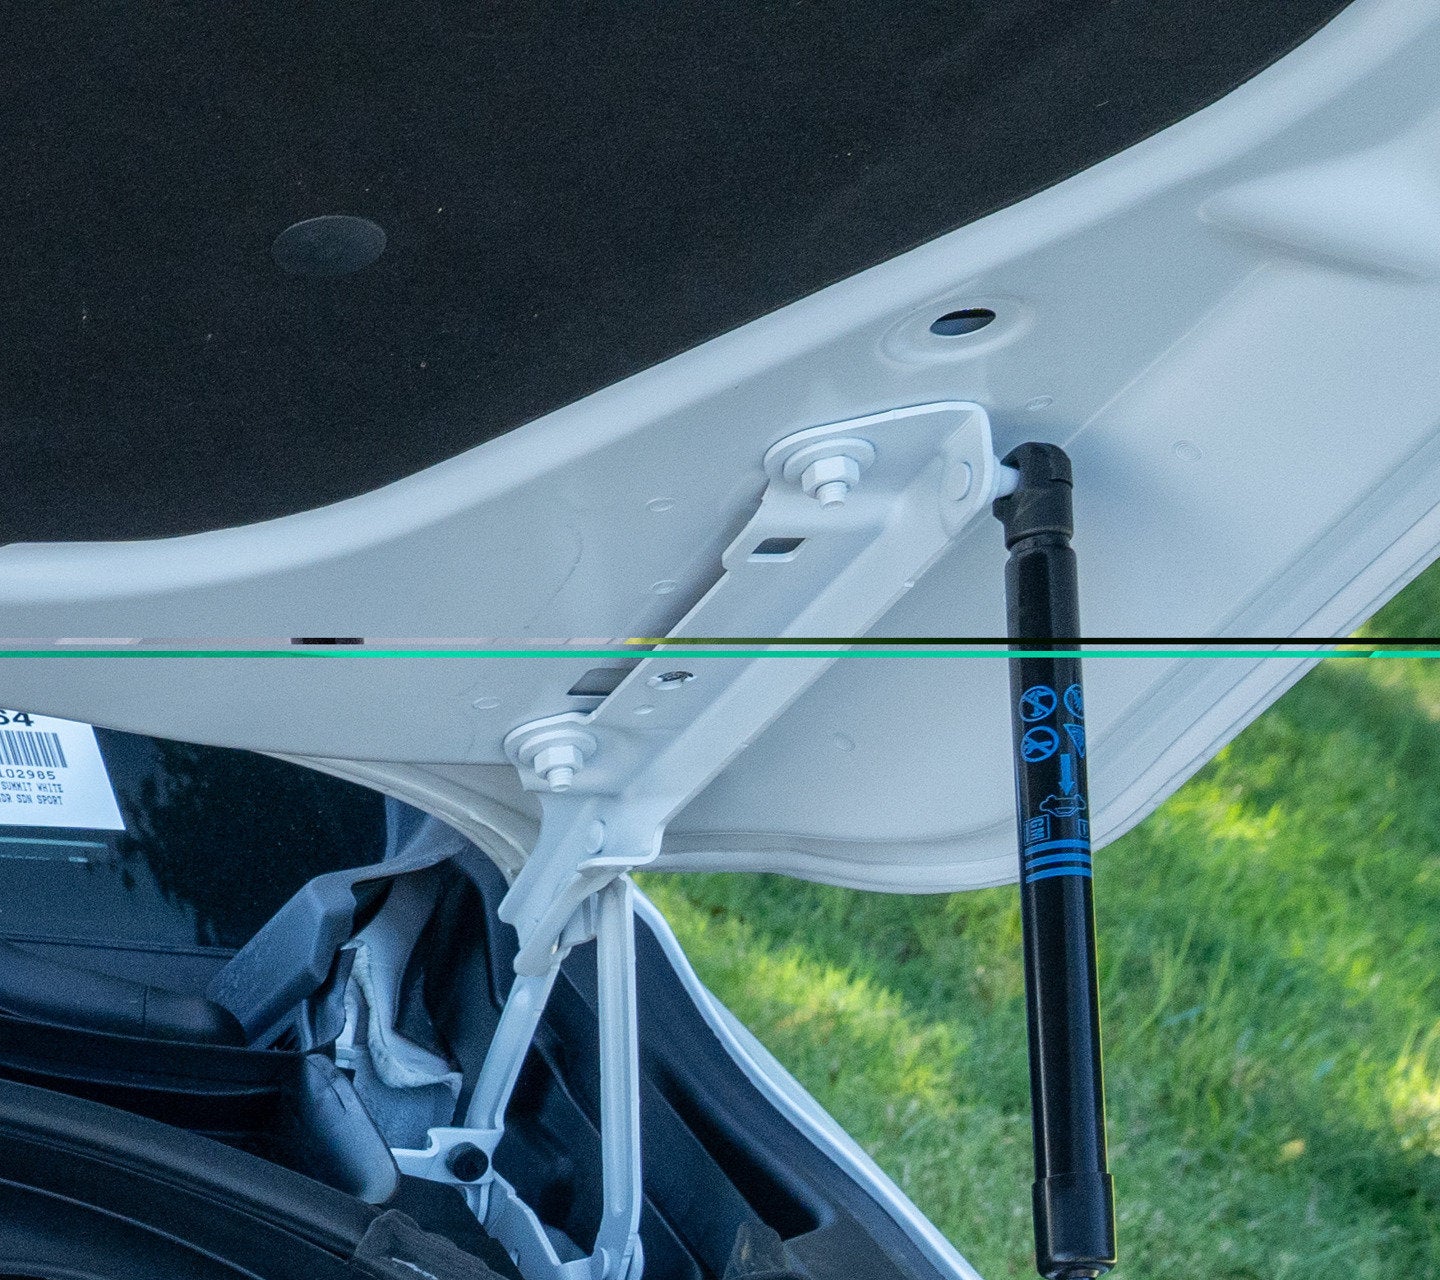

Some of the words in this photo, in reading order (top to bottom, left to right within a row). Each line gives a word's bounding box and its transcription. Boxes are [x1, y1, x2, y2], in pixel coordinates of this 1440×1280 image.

[1, 781, 33, 792] SUMMIT
[37, 784, 64, 793] WHITE
[37, 796, 63, 805] SPORT
